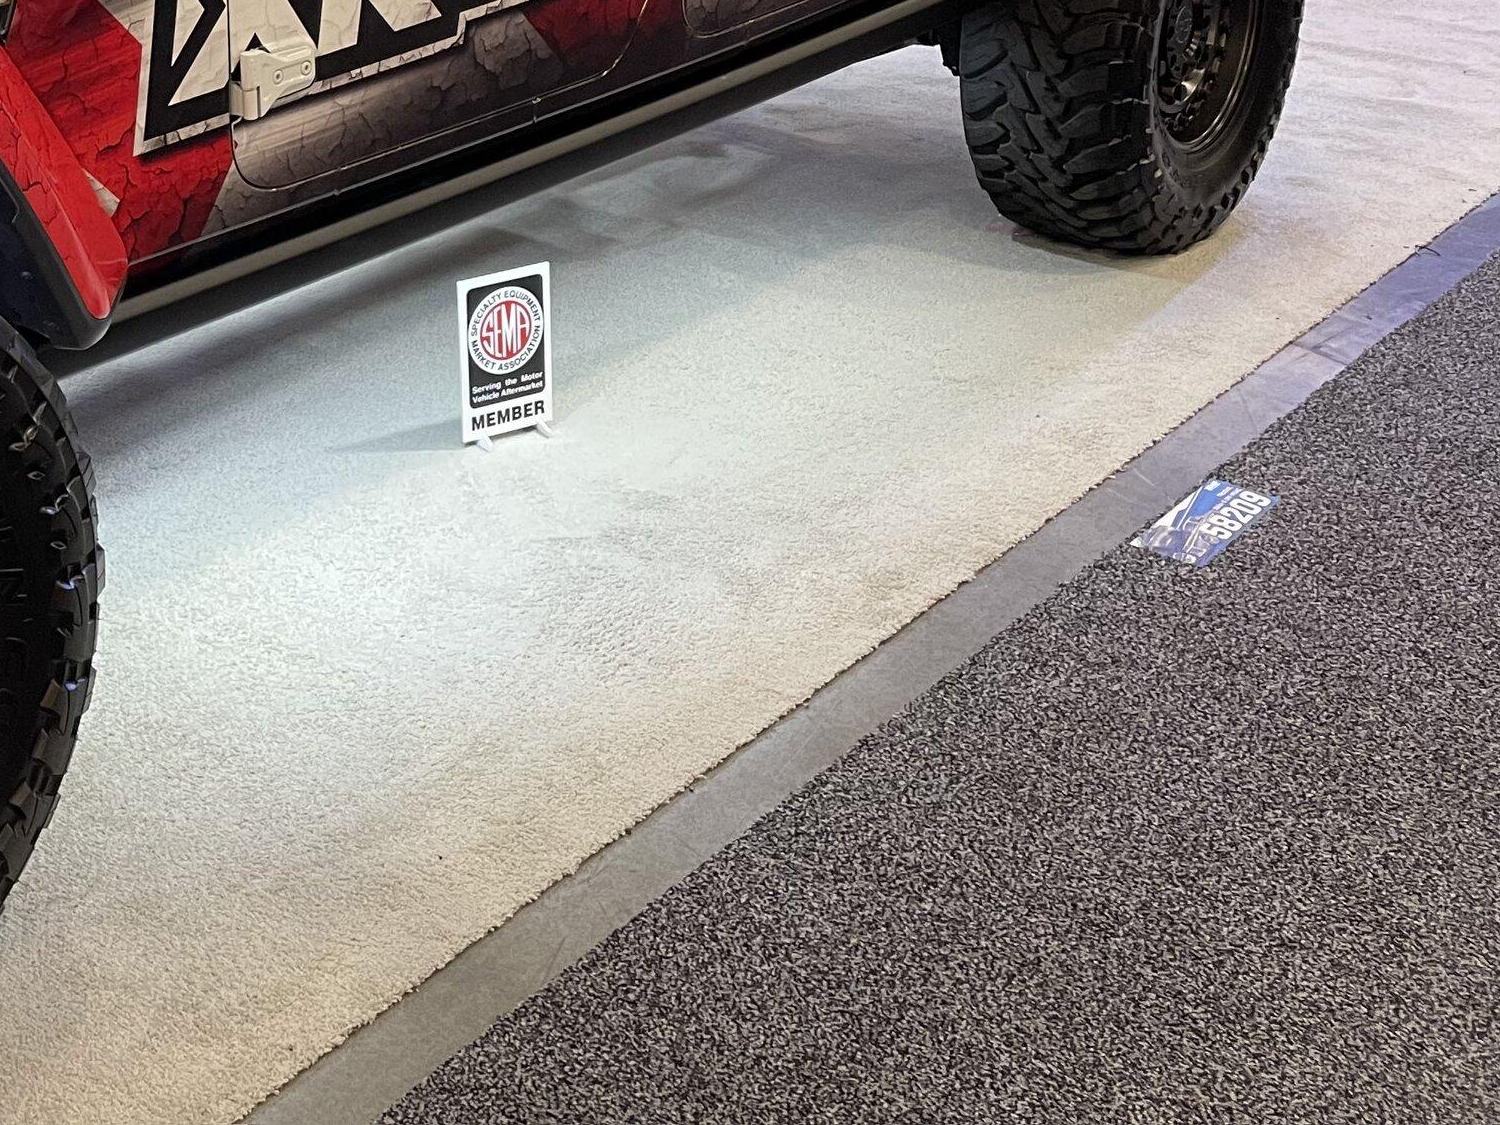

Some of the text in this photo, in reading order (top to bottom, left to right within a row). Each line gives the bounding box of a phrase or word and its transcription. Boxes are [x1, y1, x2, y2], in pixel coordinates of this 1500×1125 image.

[471, 288, 541, 371] SPECIALTY EQUIPMENT MARKET ASSOCIATION
[481, 302, 530, 359] SEMA
[472, 371, 544, 395] Serving the Motor
[472, 380, 544, 405] Vehicle Aftermarket
[471, 400, 546, 432] MEMBER
[1199, 490, 1272, 540] 58209
